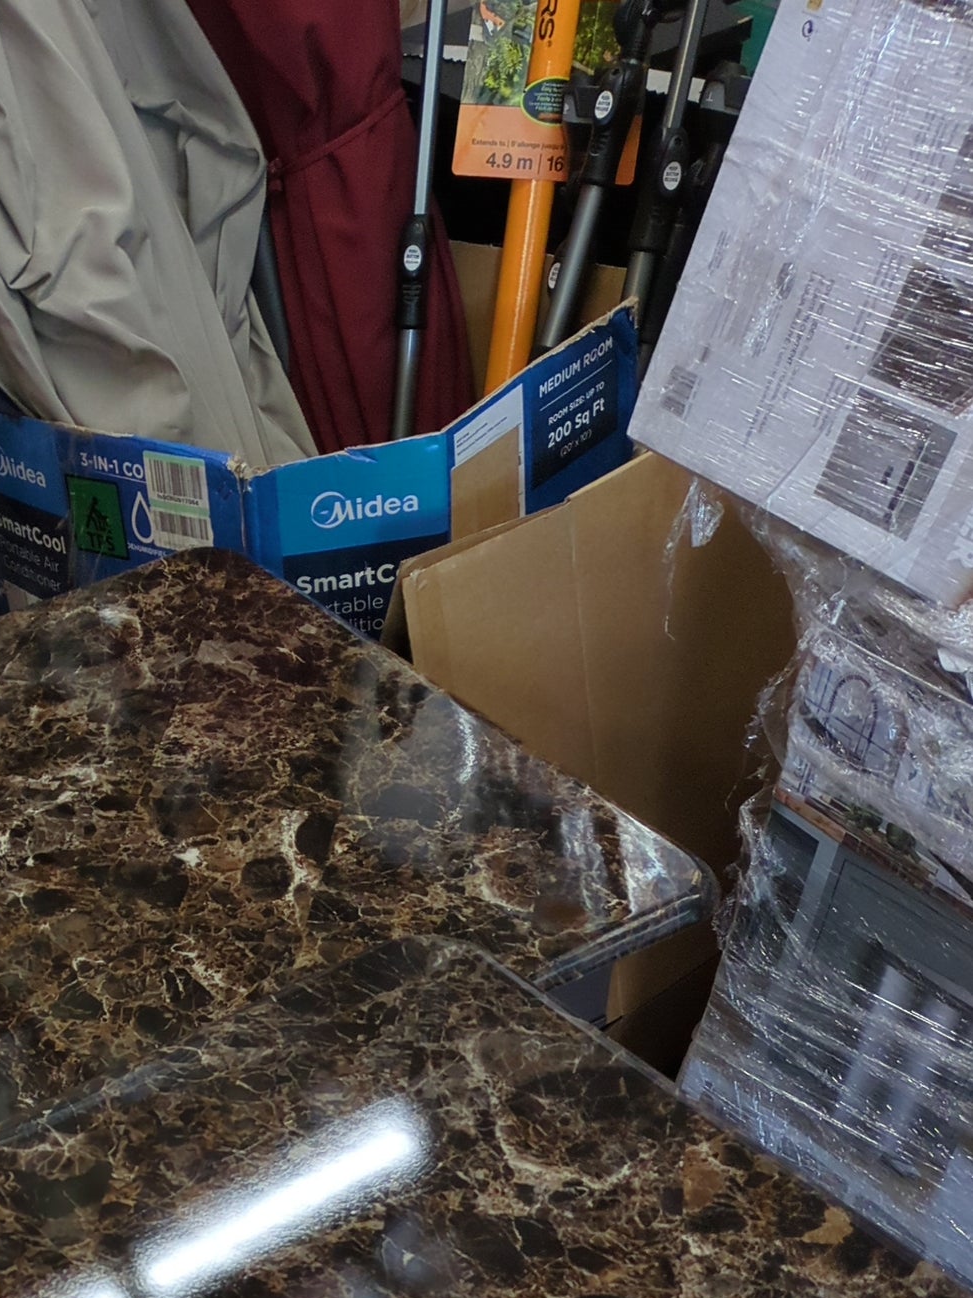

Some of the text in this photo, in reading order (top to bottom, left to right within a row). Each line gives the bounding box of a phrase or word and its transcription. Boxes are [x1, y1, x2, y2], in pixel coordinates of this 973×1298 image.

[486, 153, 564, 172] 4.9 m 16
[539, 336, 613, 398] MEDIUM ROOM
[548, 405, 568, 426] ROOM
[585, 388, 595, 400] UP
[595, 381, 605, 392] TO
[547, 398, 605, 448] 200 Sq Ft
[80, 452, 144, 479] 3-IN-1 CO
[311, 490, 419, 529] Midea
[296, 563, 399, 594] SmartC
[326, 594, 384, 615] rtable
